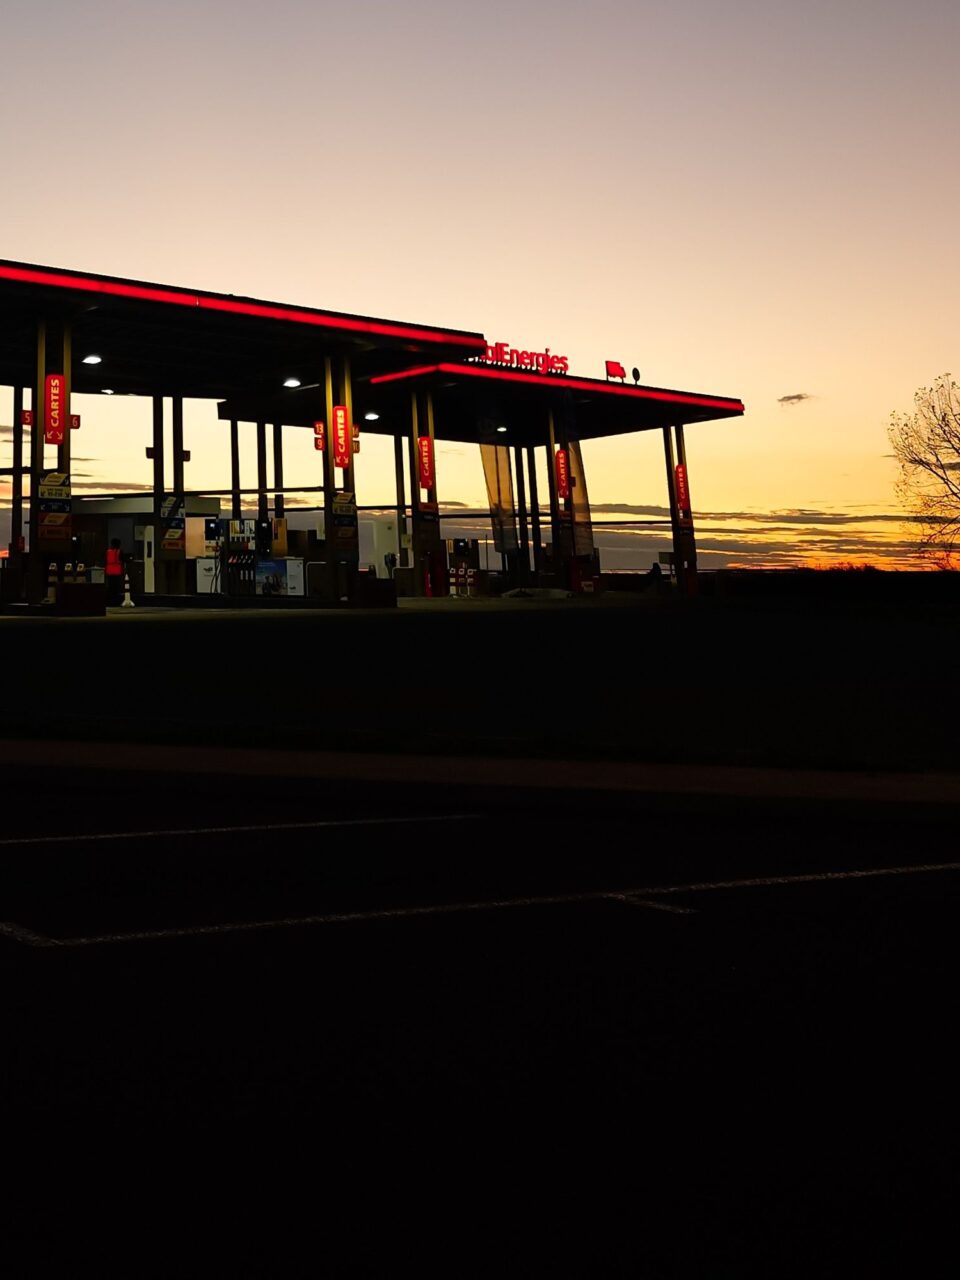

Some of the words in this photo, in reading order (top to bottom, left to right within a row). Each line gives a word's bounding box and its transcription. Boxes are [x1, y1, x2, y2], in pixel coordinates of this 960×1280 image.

[485, 343, 569, 374] alEnergies
[51, 378, 60, 428] CARTES
[337, 409, 346, 453] CARTES
